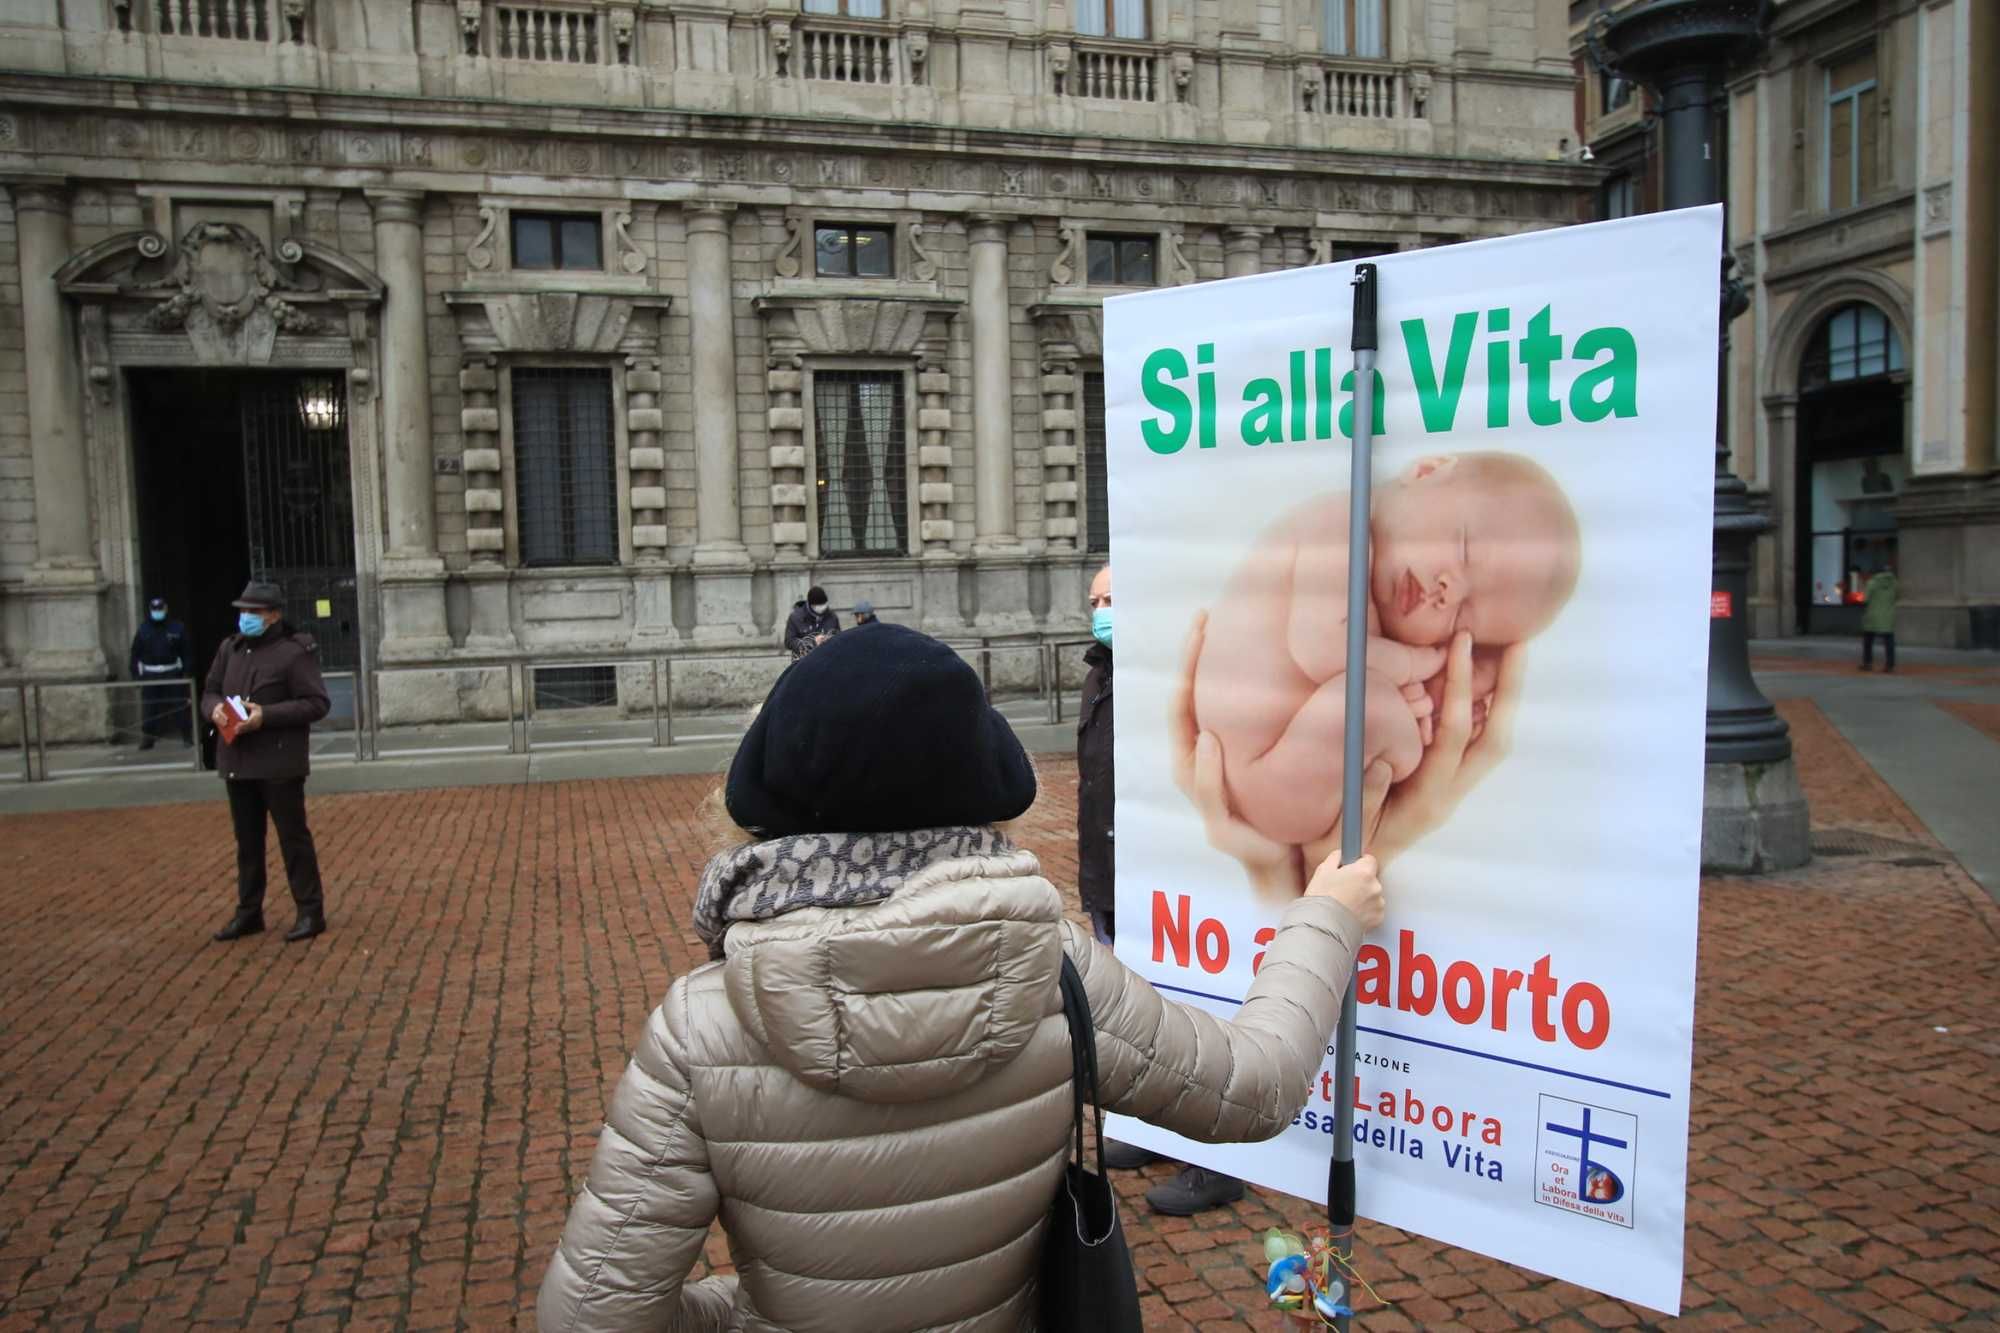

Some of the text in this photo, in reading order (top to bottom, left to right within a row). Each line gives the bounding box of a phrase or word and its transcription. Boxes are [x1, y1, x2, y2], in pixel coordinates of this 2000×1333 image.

[1141, 303, 1638, 455] Si alla Vita
[1152, 890, 1610, 1051] No aborto
[1354, 1076, 1502, 1146] Labora
[1353, 1119, 1424, 1160] della
[1442, 1140, 1503, 1182] Vita
[1551, 1162, 1569, 1175] Ora
[1542, 1181, 1577, 1199] Labora
[1554, 1176, 1565, 1185] et
[1552, 1196, 1581, 1210] Difesa
[1583, 1205, 1605, 1217] della
[1607, 1211, 1625, 1223] Vita
